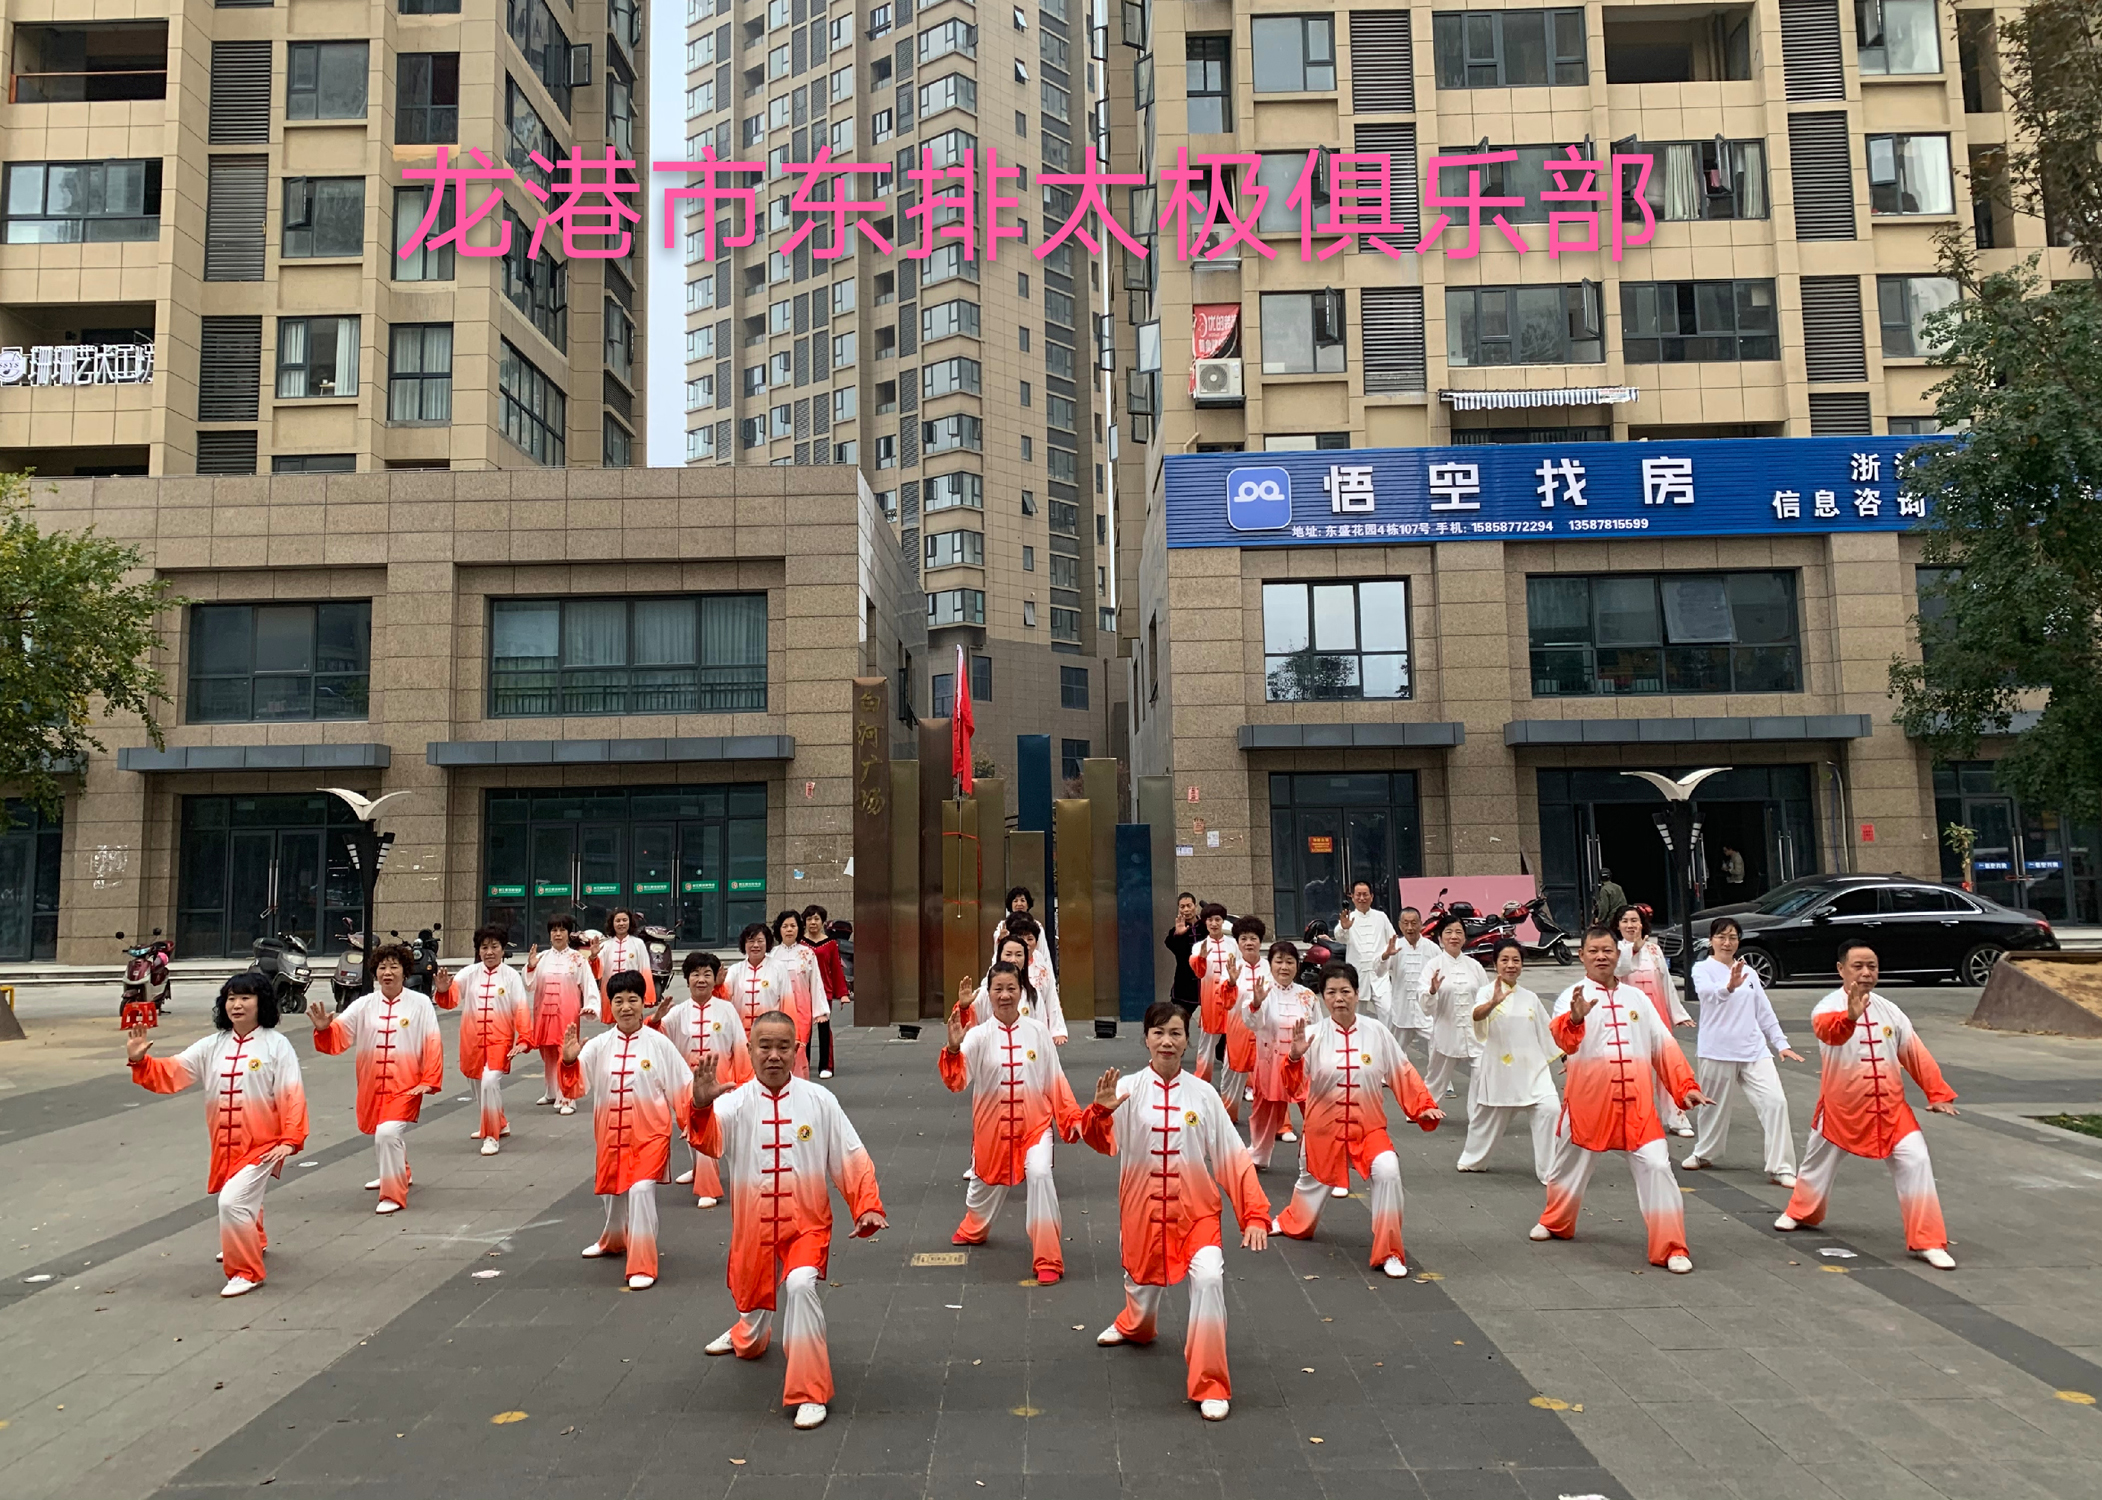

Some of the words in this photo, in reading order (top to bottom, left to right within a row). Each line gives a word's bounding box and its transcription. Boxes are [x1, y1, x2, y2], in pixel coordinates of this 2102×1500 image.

[1322, 456, 1695, 513] 悟空找房
[1568, 518, 1649, 531] 13587815599
